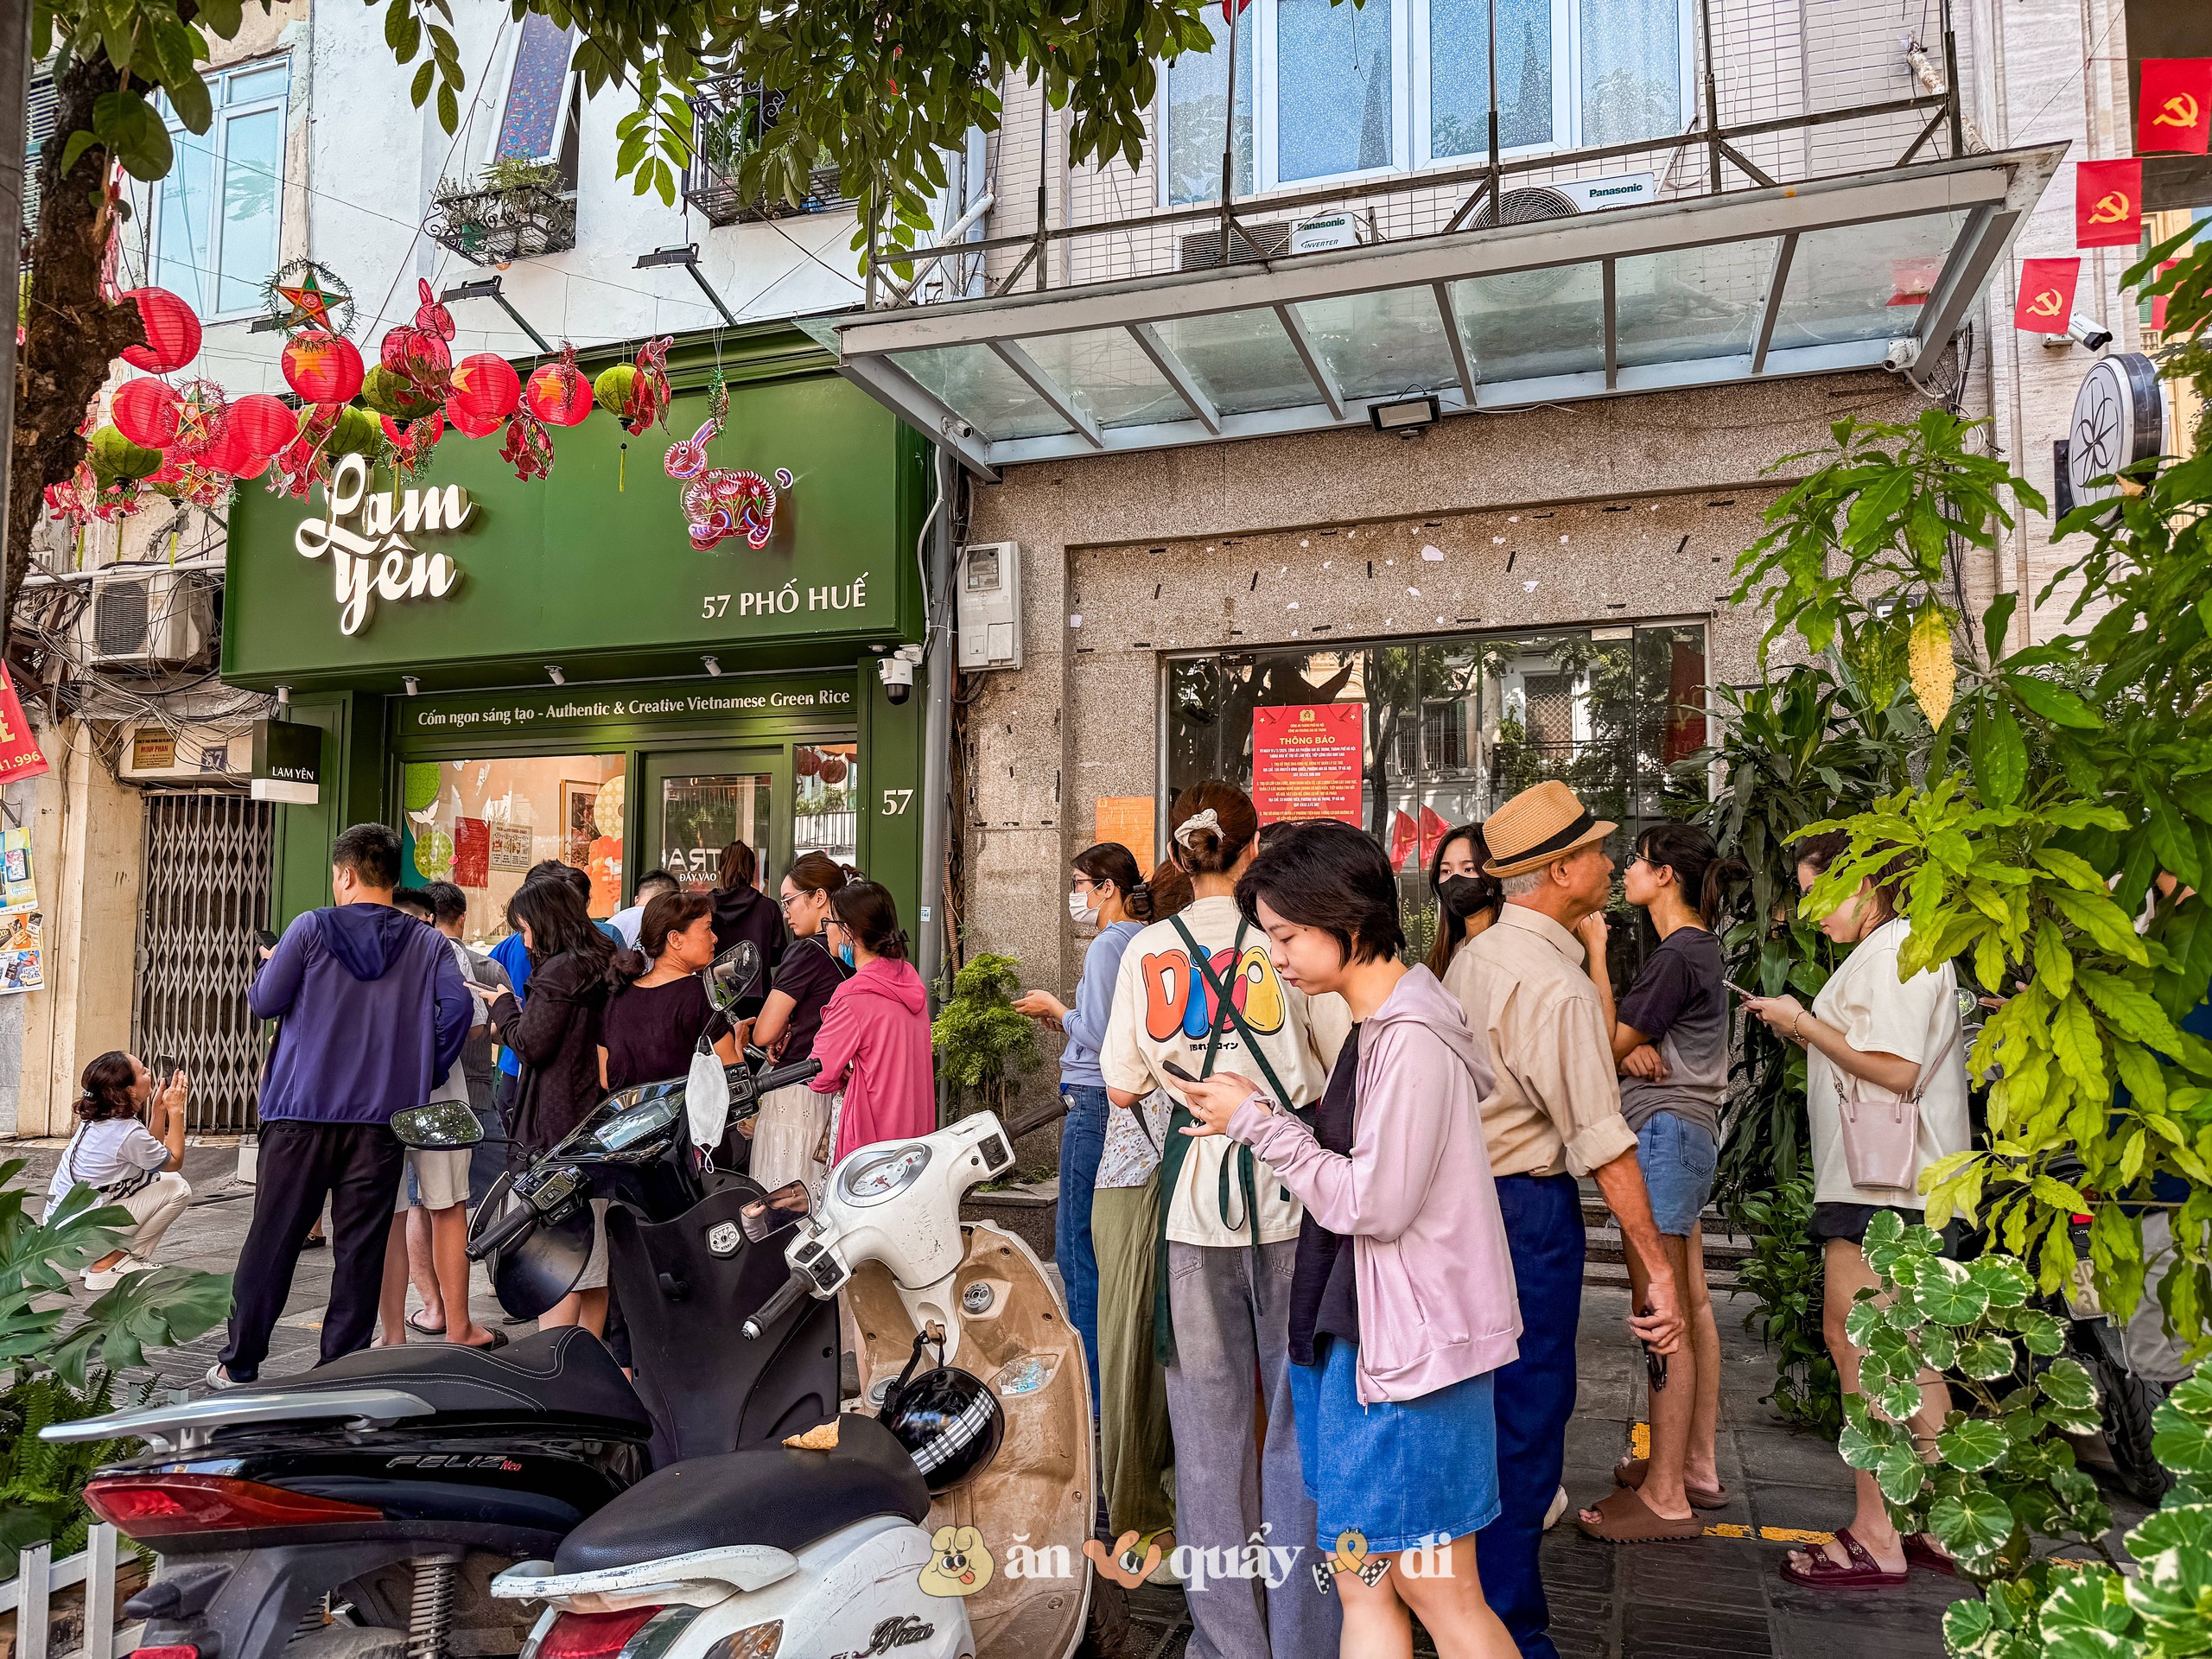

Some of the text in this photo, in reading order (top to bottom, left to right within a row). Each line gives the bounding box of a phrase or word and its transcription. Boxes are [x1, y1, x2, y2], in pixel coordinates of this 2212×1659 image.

[1589, 183, 1643, 198] Panasonic
[1303, 239, 1339, 249] INVERTER
[295, 452, 475, 558] Lam
[701, 571, 869, 619] 57 PHỐ HUẾ
[417, 709, 447, 726] Cốm
[449, 711, 480, 728] ngon
[482, 707, 512, 725] sáng
[514, 707, 535, 724] tạo
[545, 702, 610, 718] Authentic
[613, 701, 626, 715] &
[628, 698, 684, 715] Creative
[687, 695, 766, 711] Vietnamese
[770, 692, 815, 707] Green
[818, 690, 850, 704] Rice
[1279, 734, 1336, 746] THÔNG BÁO
[272, 766, 315, 781] LAM YÊN
[881, 789, 914, 816] 57
[386, 1455, 523, 1471] FELIZ Neo
